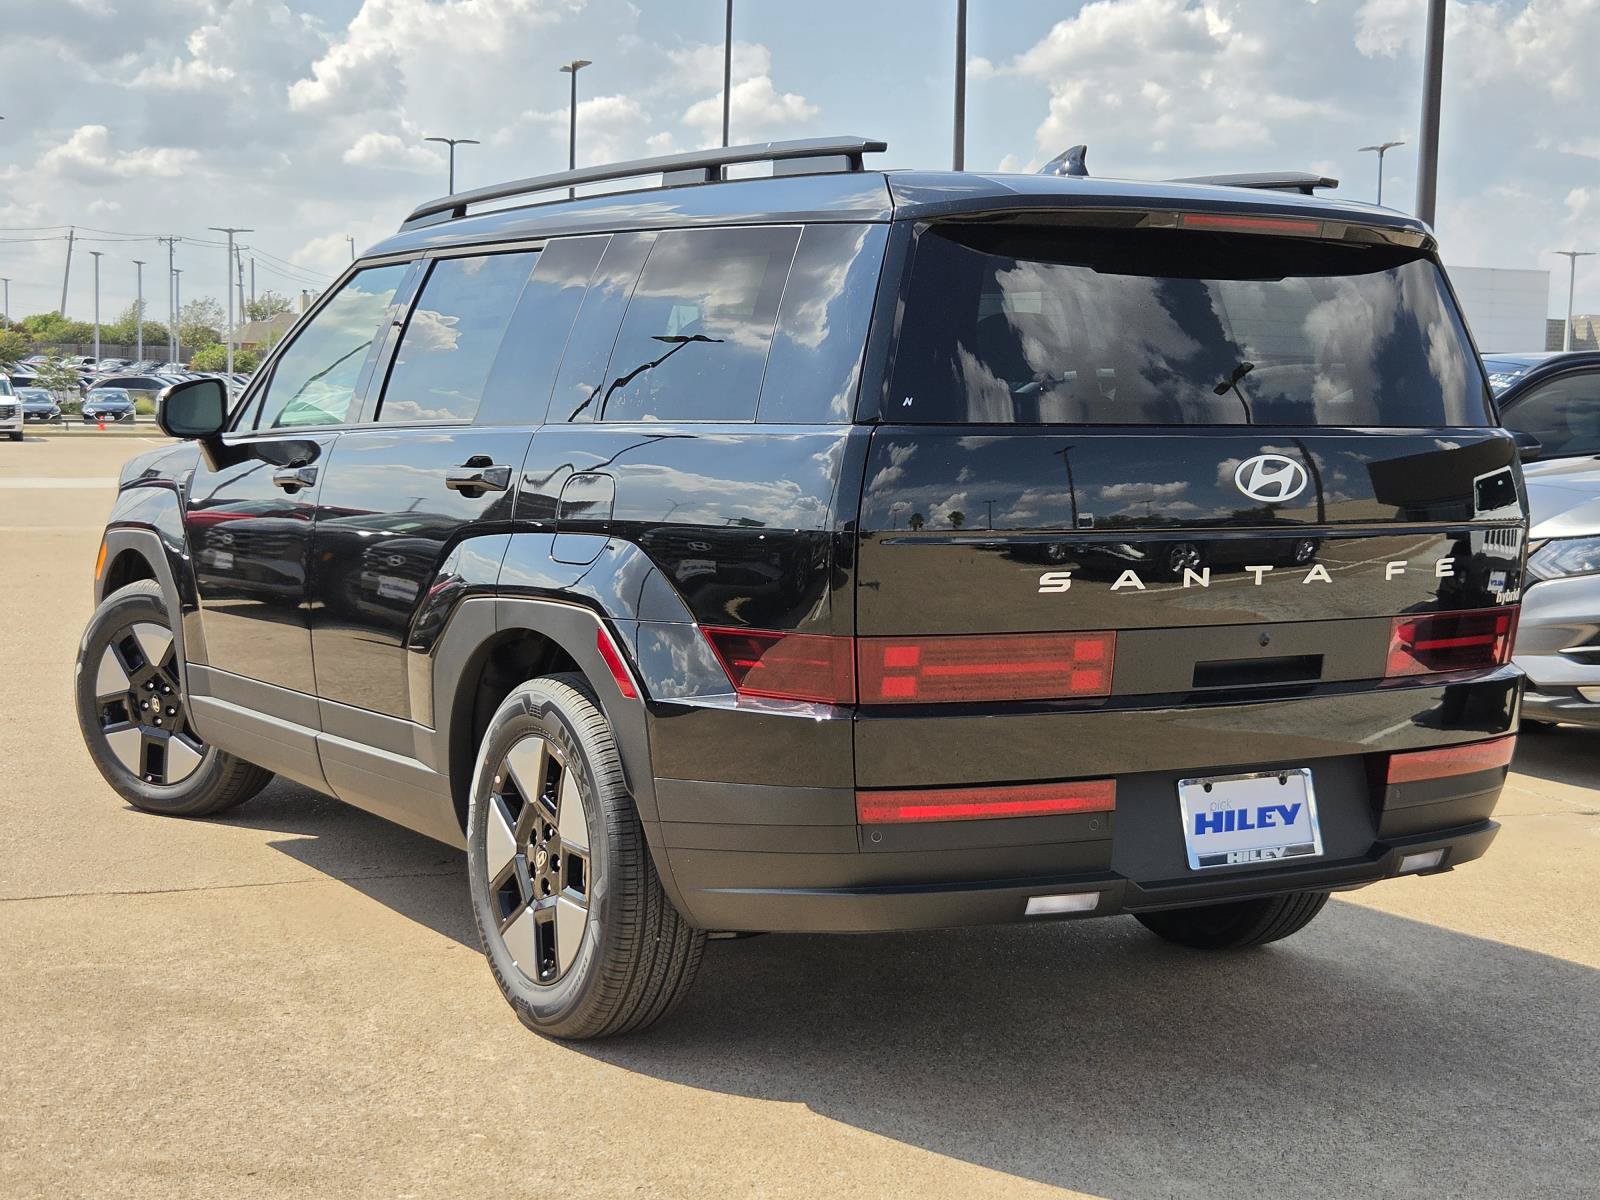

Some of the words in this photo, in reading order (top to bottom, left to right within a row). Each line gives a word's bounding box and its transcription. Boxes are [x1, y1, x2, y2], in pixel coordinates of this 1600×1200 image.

[1038, 563, 1332, 593] SANTA
[1385, 557, 1456, 580] FE
[1194, 803, 1302, 835] HILEY
[1227, 847, 1287, 864] HILEY
